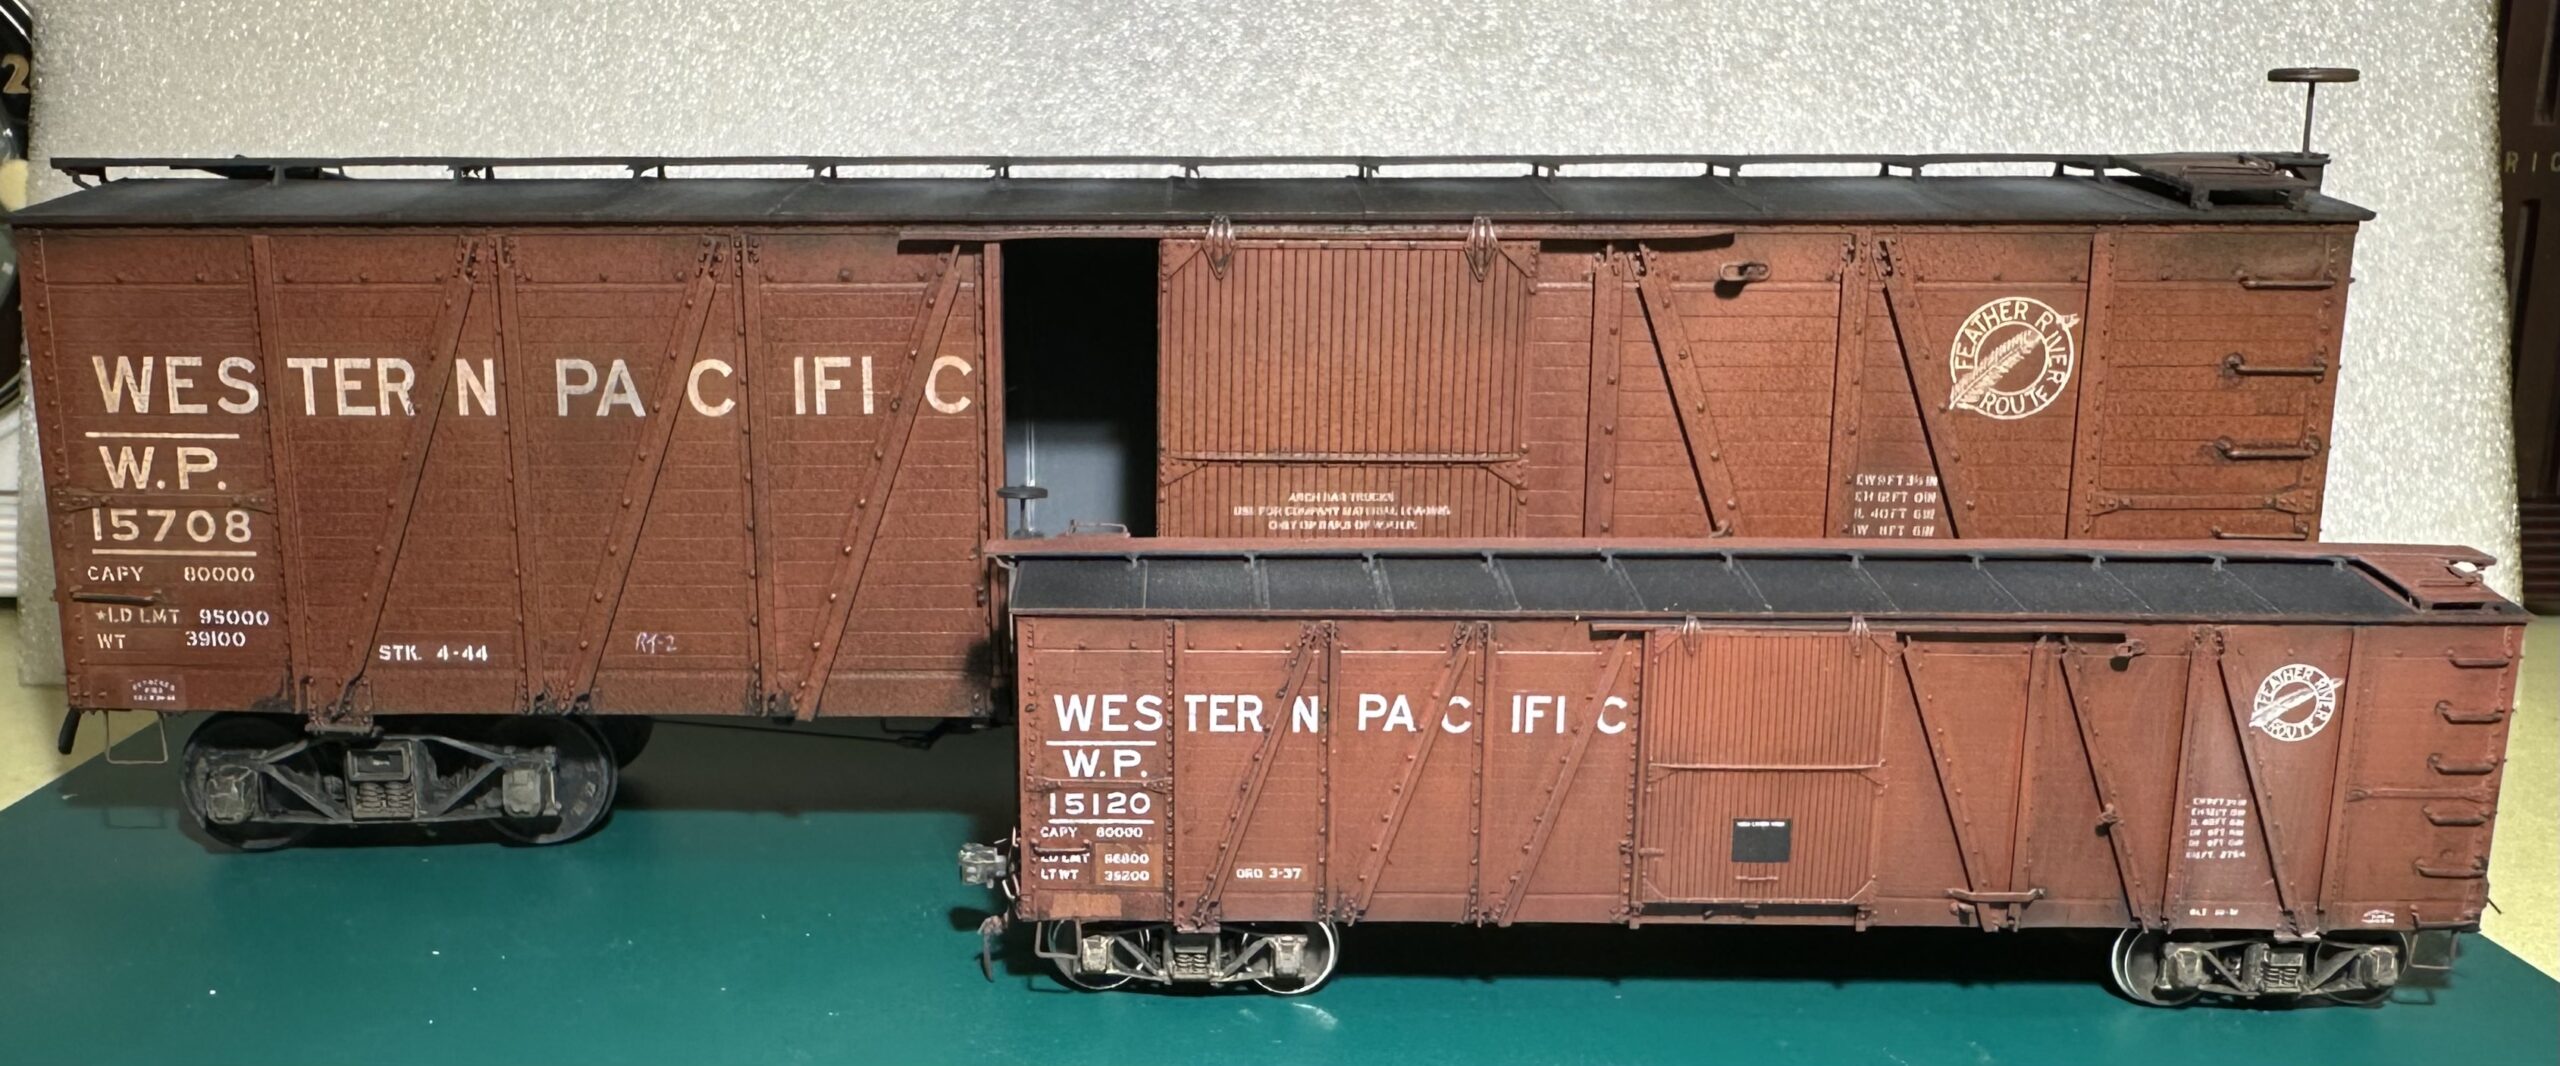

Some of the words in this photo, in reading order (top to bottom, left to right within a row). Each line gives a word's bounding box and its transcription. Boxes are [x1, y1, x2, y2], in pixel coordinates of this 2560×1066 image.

[1955, 301, 2028, 369] FEATHER
[2035, 311, 2068, 384] RIVER
[1979, 385, 2049, 414] ROUTE
[98, 446, 227, 490] W.P.
[92, 508, 252, 543] 15708
[87, 566, 144, 581] CAPY
[184, 567, 255, 582] 80000
[140, 608, 180, 624] LMT
[199, 609, 270, 626] 95000
[97, 633, 126, 649] WT
[185, 631, 246, 647] 39100
[437, 645, 488, 661] 4-44
[1063, 749, 1148, 777] W.P.
[1049, 793, 1151, 815] 15120
[1040, 827, 1077, 838] CAPY
[1096, 827, 1143, 838] 80000
